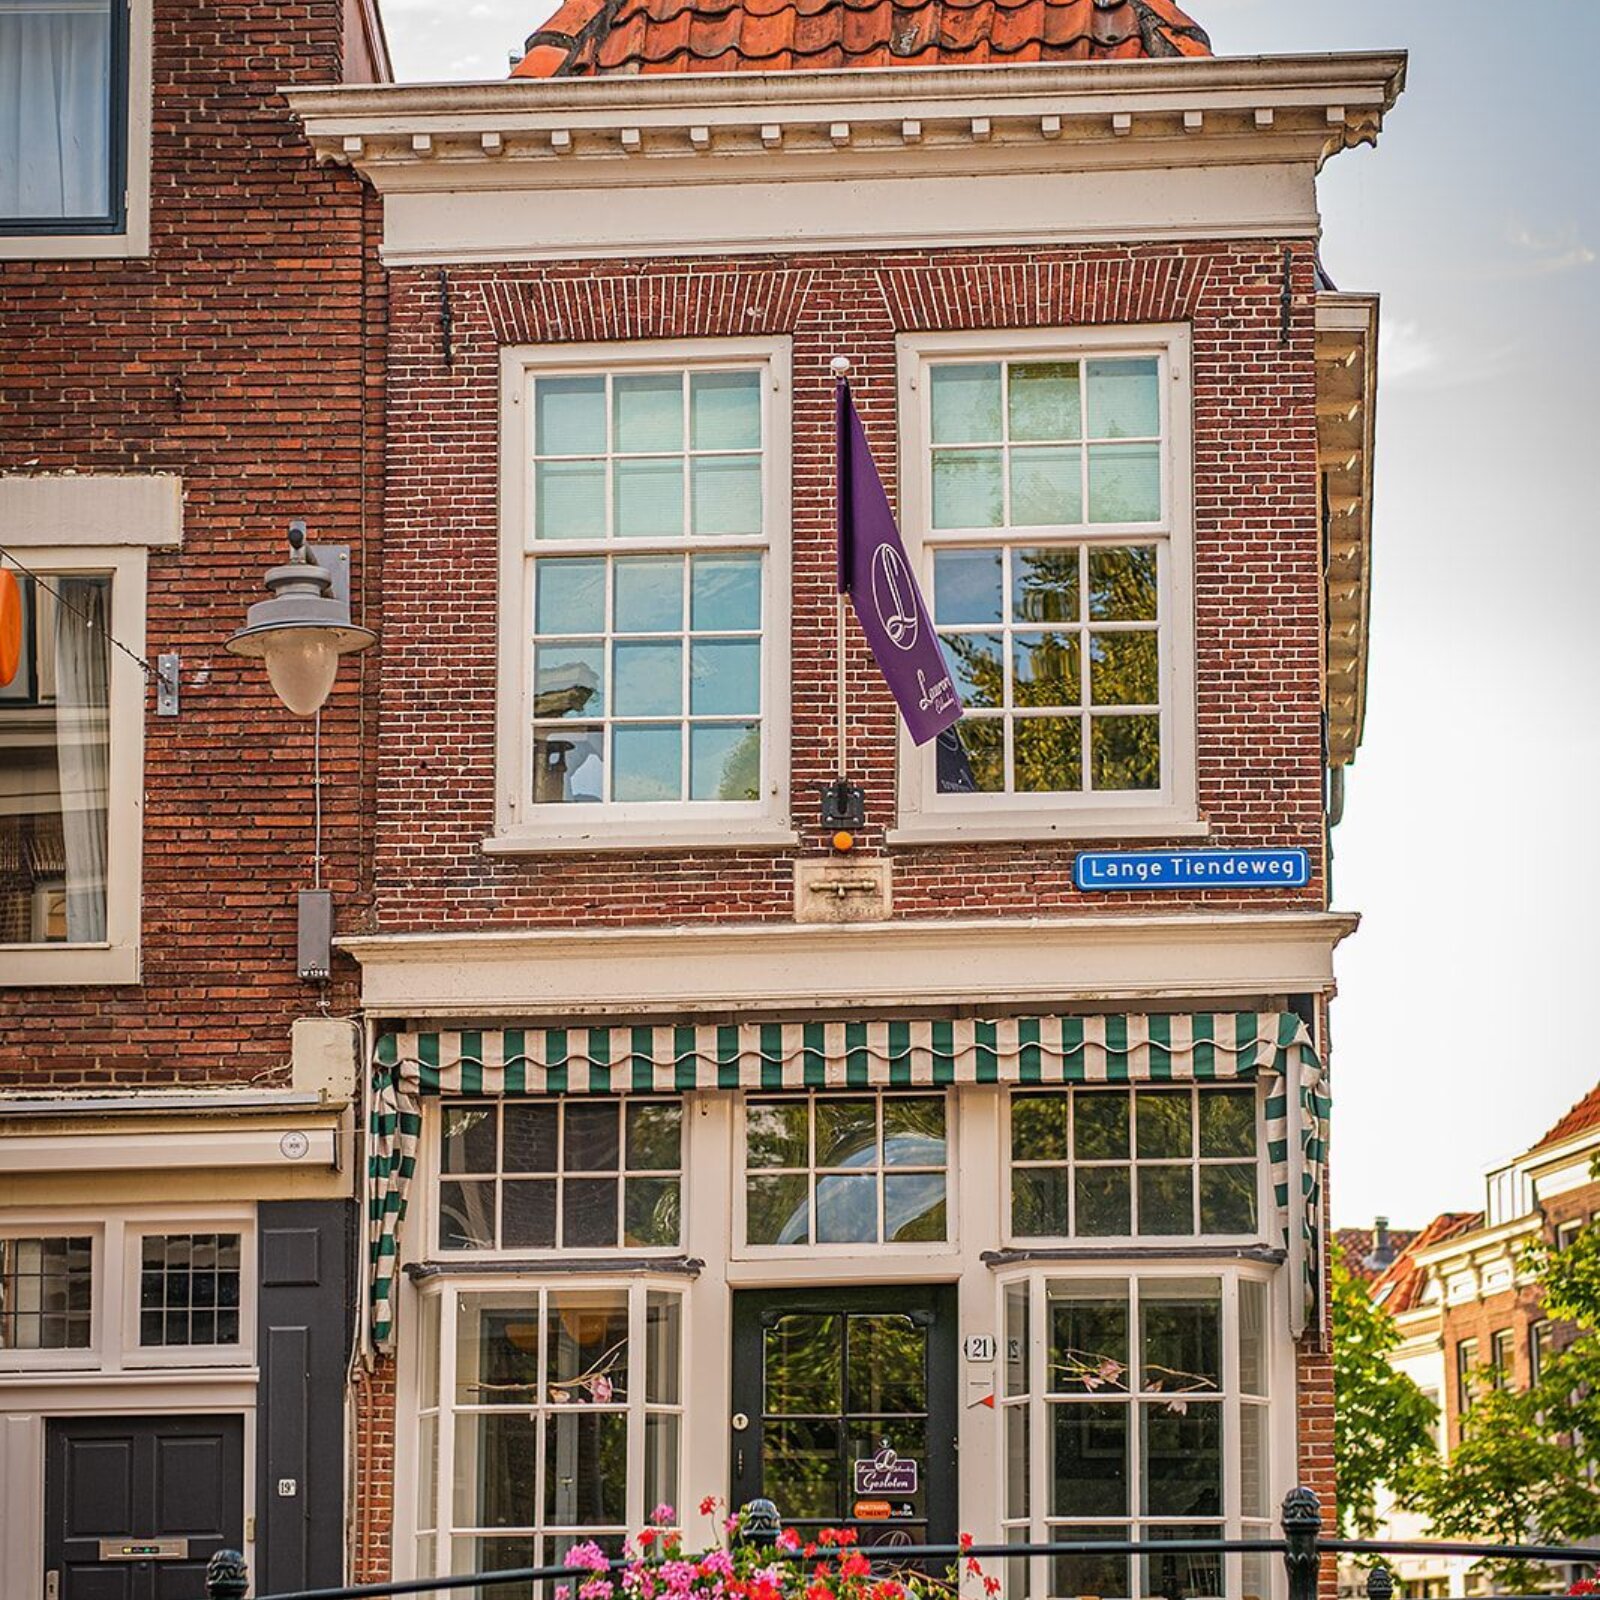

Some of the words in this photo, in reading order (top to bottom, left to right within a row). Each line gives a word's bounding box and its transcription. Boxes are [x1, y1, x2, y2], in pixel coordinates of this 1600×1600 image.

[1091, 859, 1162, 881] Lange
[1170, 857, 1295, 880] Tiendeweg
[972, 1338, 987, 1358] 21
[863, 1473, 908, 1492] Gesloten
